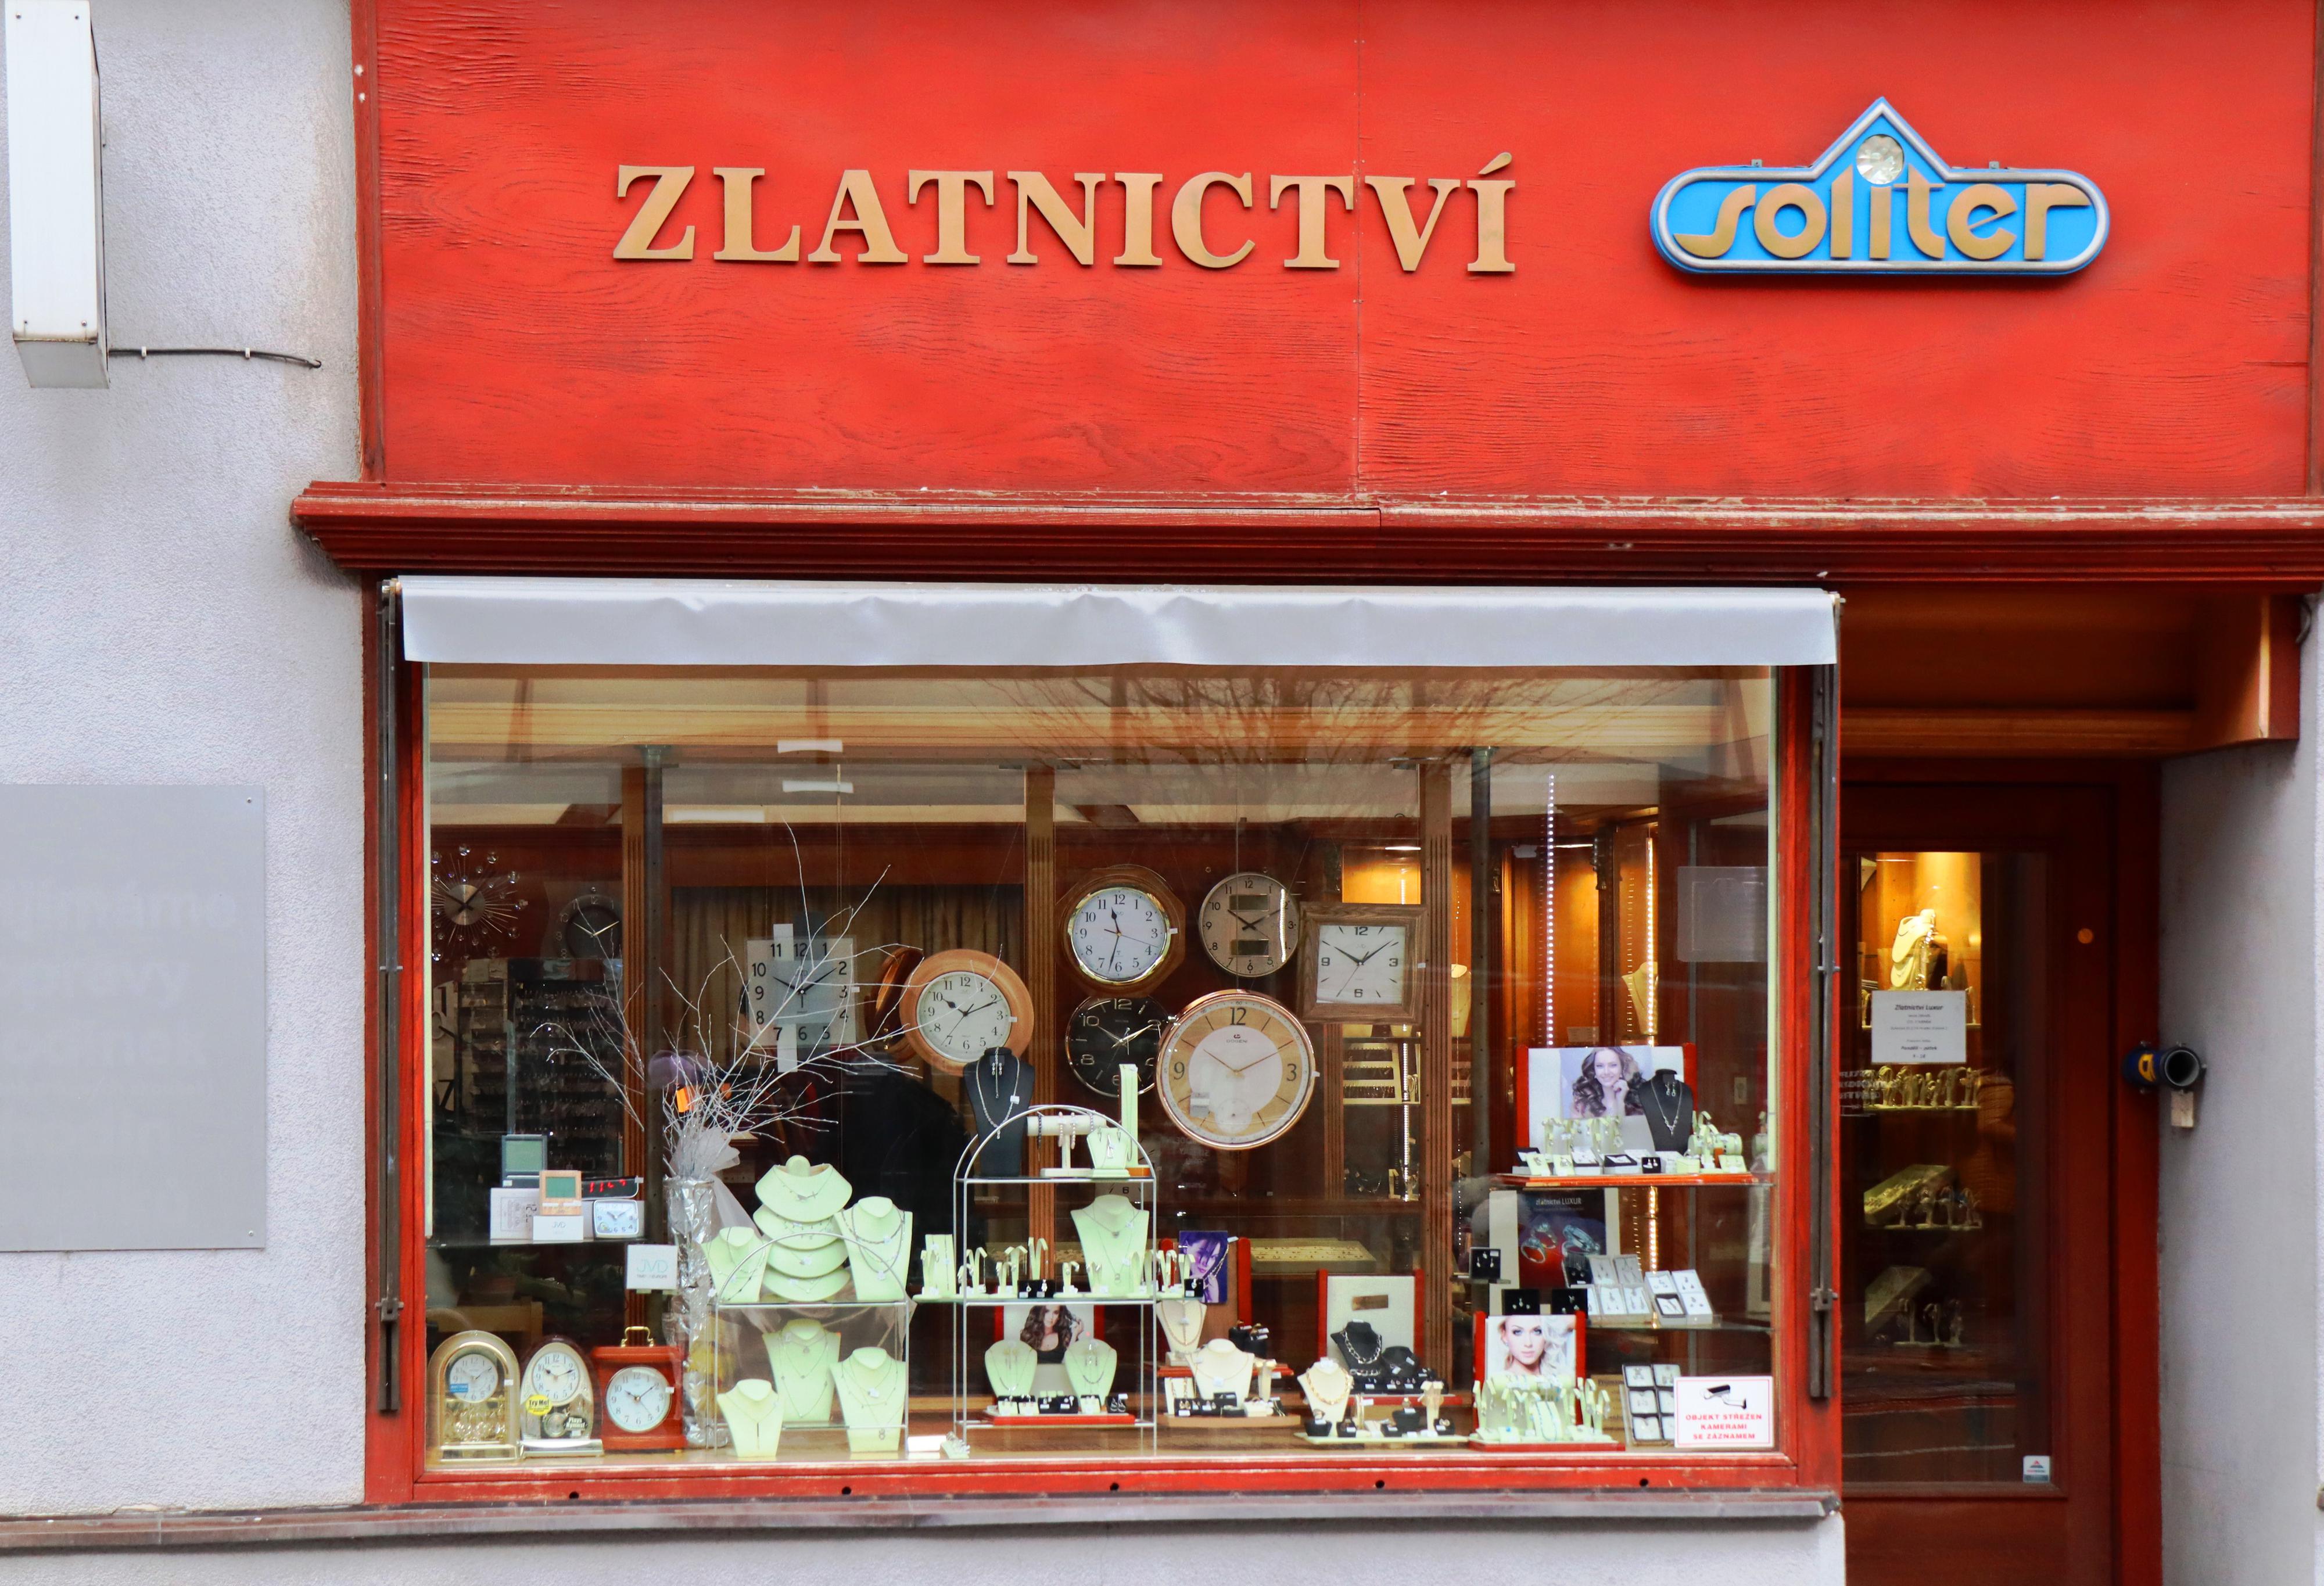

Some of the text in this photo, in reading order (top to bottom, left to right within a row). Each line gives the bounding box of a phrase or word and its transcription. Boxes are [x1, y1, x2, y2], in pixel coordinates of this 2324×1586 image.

[613, 152, 1515, 272] ZLATNICTVÍ
[1673, 163, 2092, 261] soliter
[1245, 880, 1253, 888] 12
[1225, 885, 1232, 894] 11
[1098, 899, 1106, 909] 11
[1114, 894, 1125, 905] 12
[1135, 899, 1138, 909] 1
[1085, 912, 1096, 922] 10
[1146, 911, 1153, 921] 2
[1205, 921, 1212, 930] 9
[1288, 921, 1294, 929] 3
[1079, 928, 1087, 939] 9
[1151, 928, 1158, 938] 3
[1355, 927, 1368, 935] 12
[770, 943, 781, 957] 11
[794, 943, 808, 957] 12
[823, 943, 827, 956] 1
[1086, 945, 1093, 955] 8
[1145, 945, 1152, 955] 4
[1098, 957, 1105, 968] 7
[1115, 961, 1122, 972] 6
[1132, 957, 1139, 967] 5
[1228, 957, 1233, 967] 7
[1321, 957, 1330, 966] 9
[1389, 958, 1398, 967] 3
[752, 963, 766, 977] 10
[838, 961, 847, 975] 2
[1247, 963, 1253, 971] 6
[944, 980, 953, 991] 11
[960, 977, 970, 987] 12
[755, 986, 764, 1000] 9
[933, 992, 943, 1002] 10
[1354, 989, 1363, 997] 6
[991, 994, 998, 1003] 2
[1114, 998, 1132, 1010] 12
[756, 1010, 765, 1024] 8
[840, 1009, 848, 1022] 4
[928, 1007, 935, 1017] 9
[996, 1010, 1003, 1020] 3
[1229, 1007, 1247, 1025] 12
[1082, 1016, 1099, 1027] 10
[934, 1023, 941, 1032] 8
[991, 1027, 998, 1036] 4
[773, 1027, 783, 1041] 7
[798, 1027, 807, 1040] 6
[822, 1027, 830, 1040] 5
[946, 1035, 953, 1045] 7
[963, 1040, 970, 1050] 6
[980, 1037, 986, 1047] 5
[1081, 1054, 1095, 1065] 8
[1174, 1062, 1185, 1079] 9
[1286, 1063, 1297, 1082] 3
[637, 1259, 669, 1273] JVD
